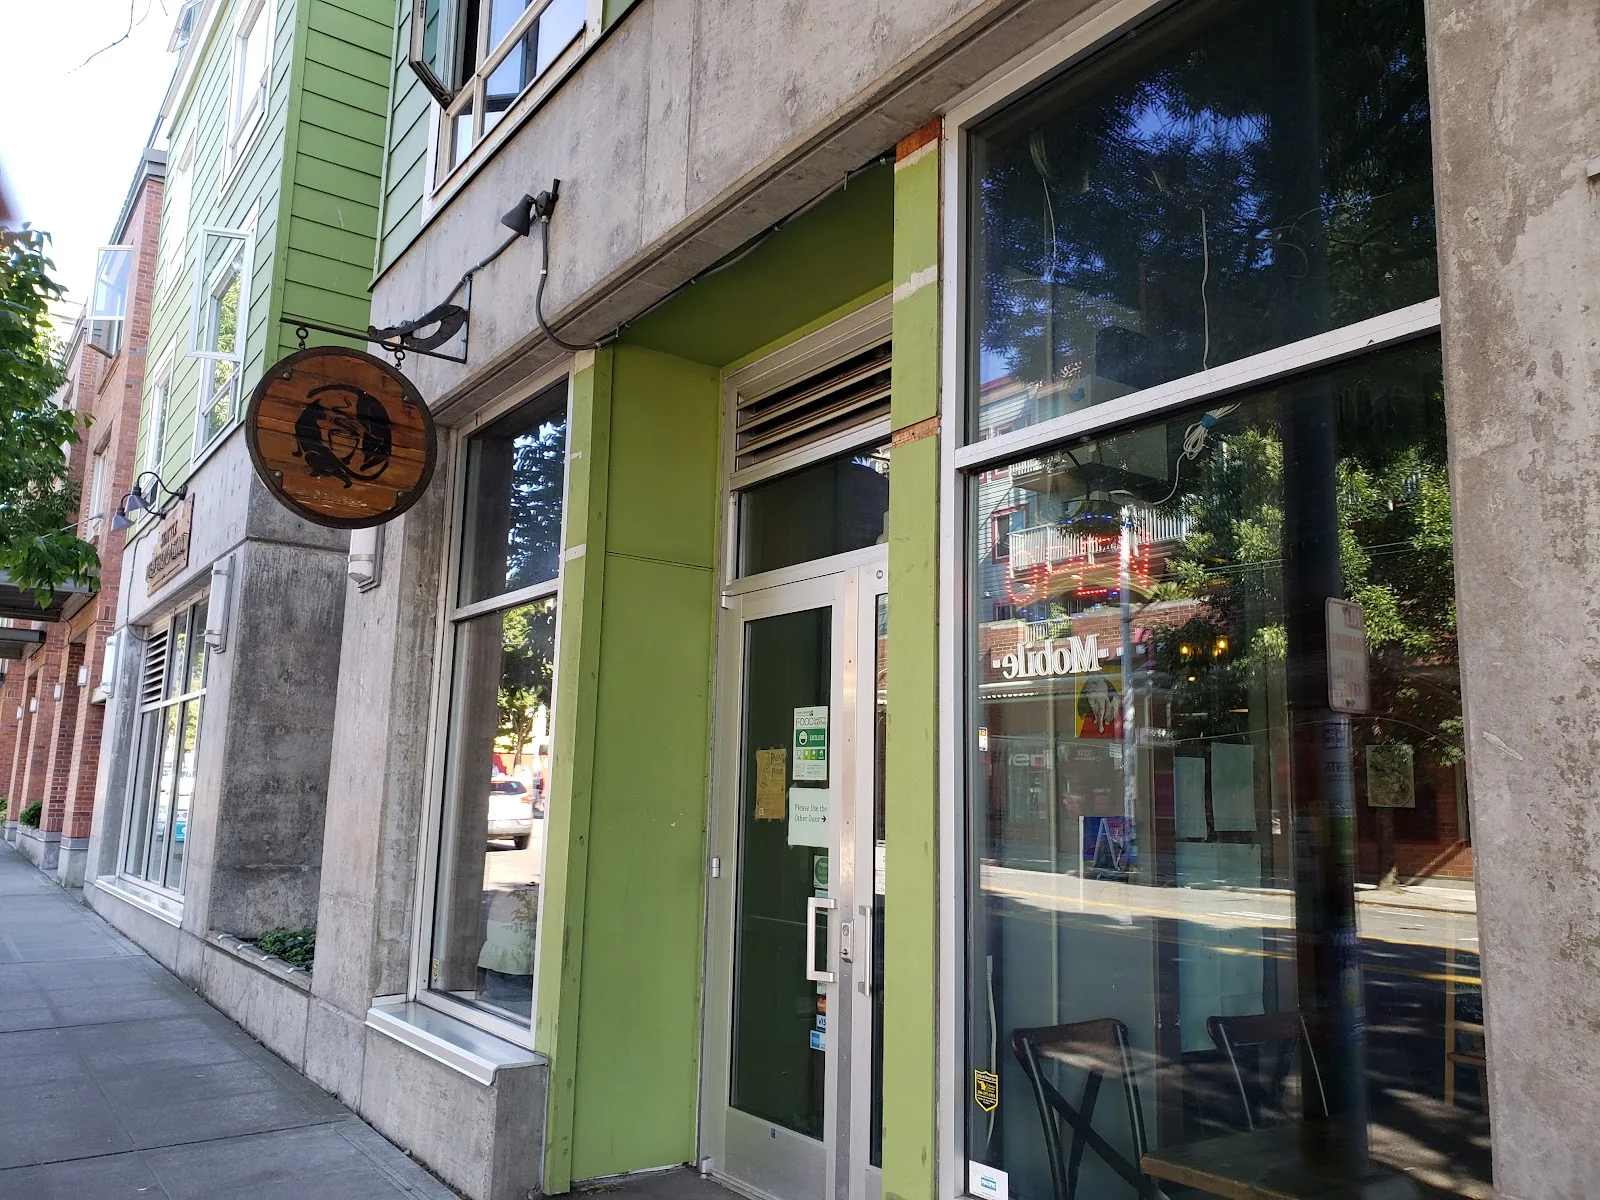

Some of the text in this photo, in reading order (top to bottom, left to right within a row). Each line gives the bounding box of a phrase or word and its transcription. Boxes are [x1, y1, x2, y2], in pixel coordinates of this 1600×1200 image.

[1006, 531, 1150, 603] OPEN
[794, 803, 810, 811] Please
[819, 804, 828, 812] the
[794, 814, 820, 823] Other Door
